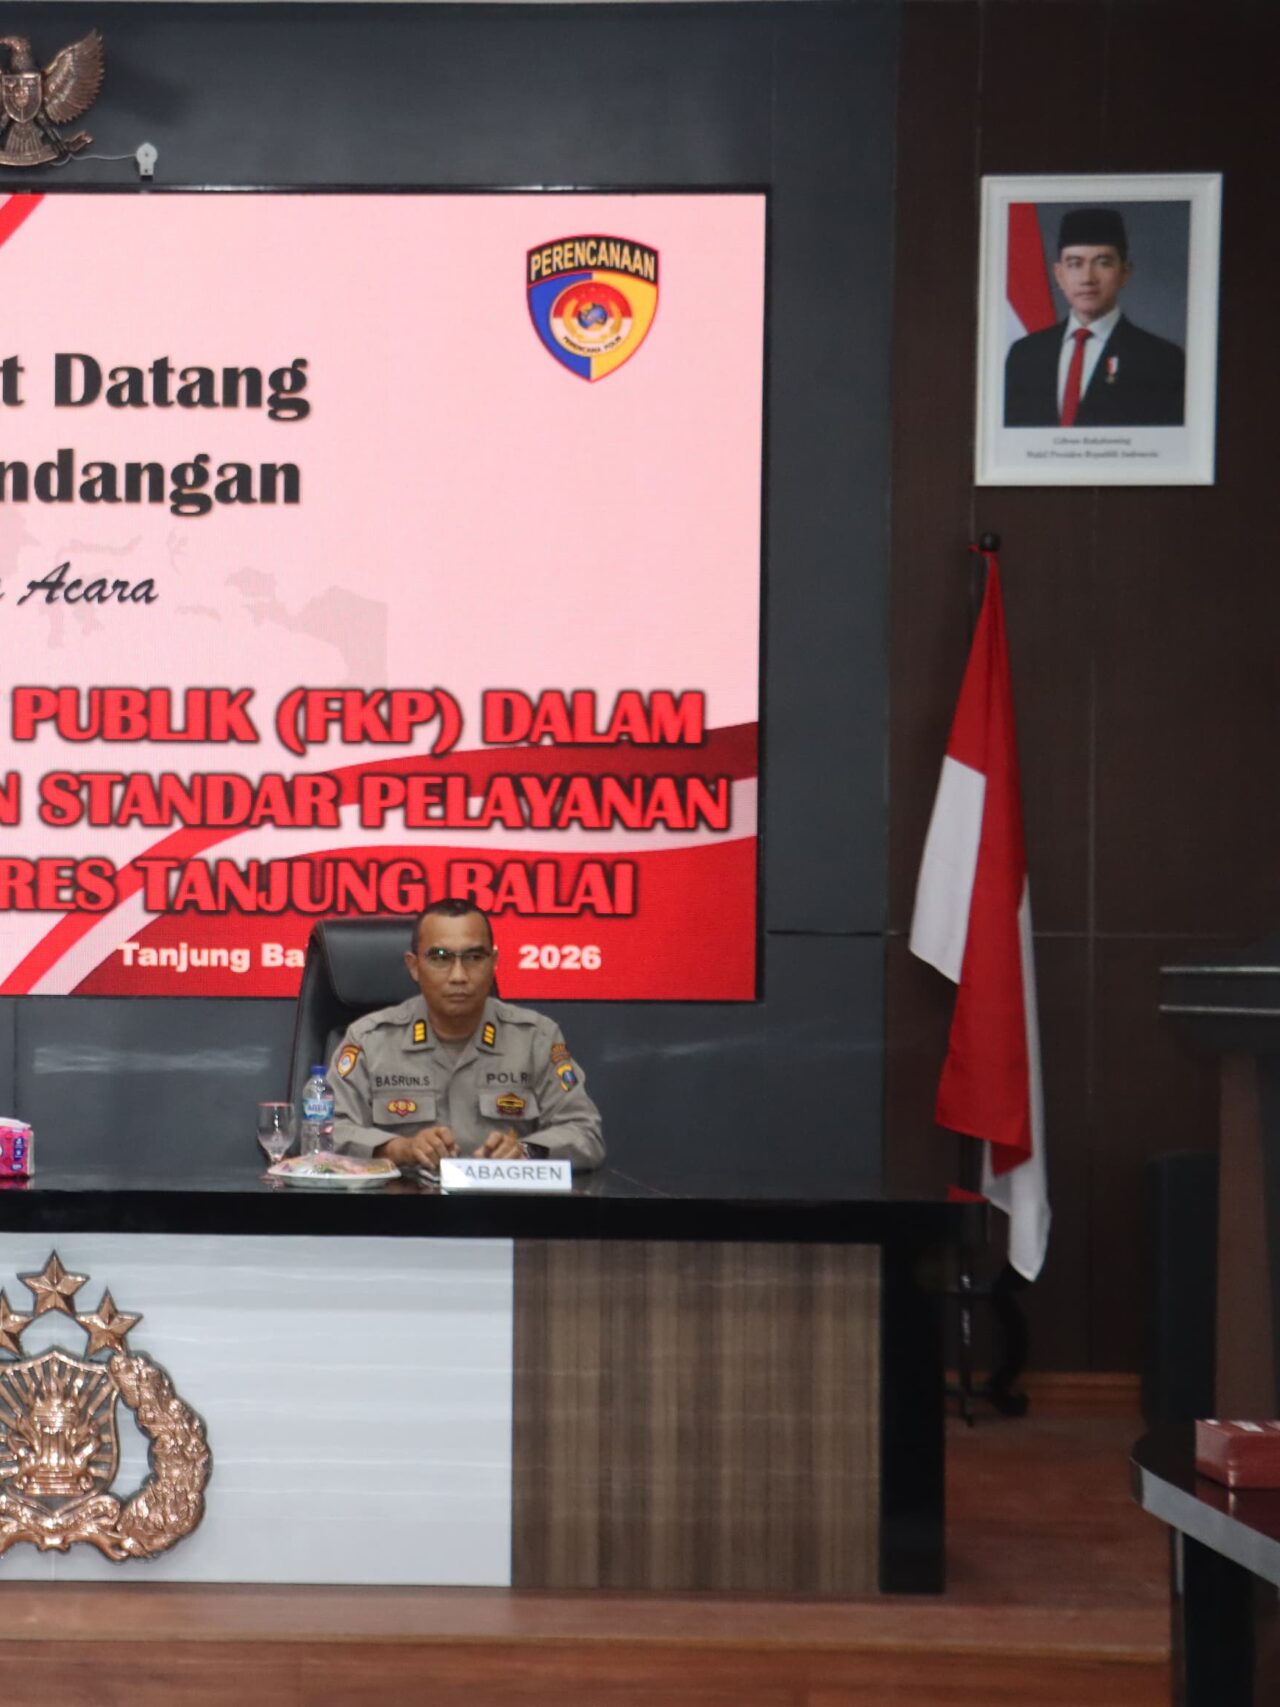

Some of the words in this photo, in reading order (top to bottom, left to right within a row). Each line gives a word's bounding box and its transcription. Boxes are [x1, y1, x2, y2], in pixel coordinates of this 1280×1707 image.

[530, 239, 655, 282] PERENCANAAN
[54, 352, 311, 422] Datang
[17, 562, 159, 605] Acara
[12, 686, 260, 744] PUBLIK
[275, 686, 464, 756] (FKP)
[481, 688, 706, 745] DALAM
[38, 772, 341, 829] STANDAR
[358, 773, 732, 832] PELAYANAN
[136, 858, 426, 916] TANJUNG
[449, 860, 639, 917] BALAI
[119, 942, 251, 973] Tanjung
[518, 944, 602, 971] 2026
[457, 1164, 562, 1181] ABAGREN
